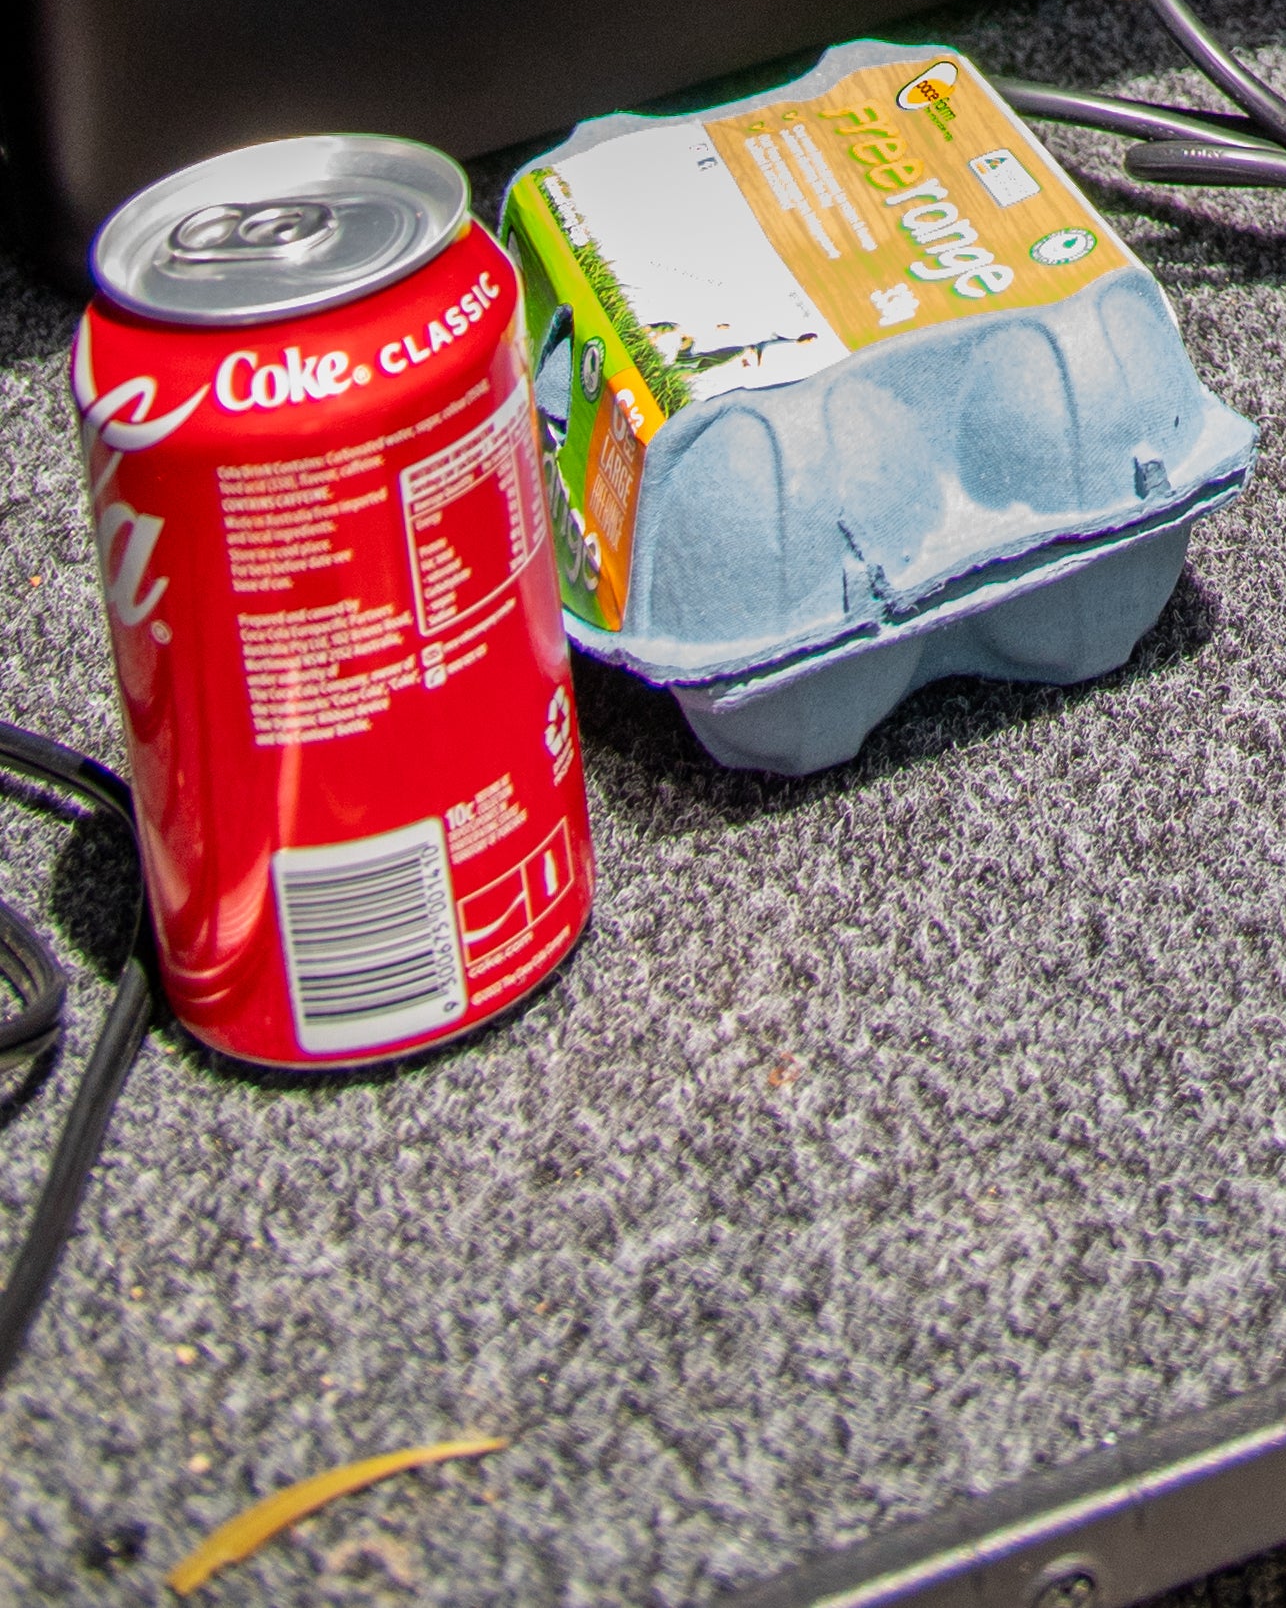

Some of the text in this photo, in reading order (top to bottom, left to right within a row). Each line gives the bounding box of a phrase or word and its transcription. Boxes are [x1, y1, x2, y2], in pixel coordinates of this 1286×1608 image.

[818, 99, 925, 191] Free
[885, 177, 1014, 298] range
[215, 347, 351, 413] Coke
[380, 271, 500, 375] CLASSIC
[600, 435, 634, 508] LARGE
